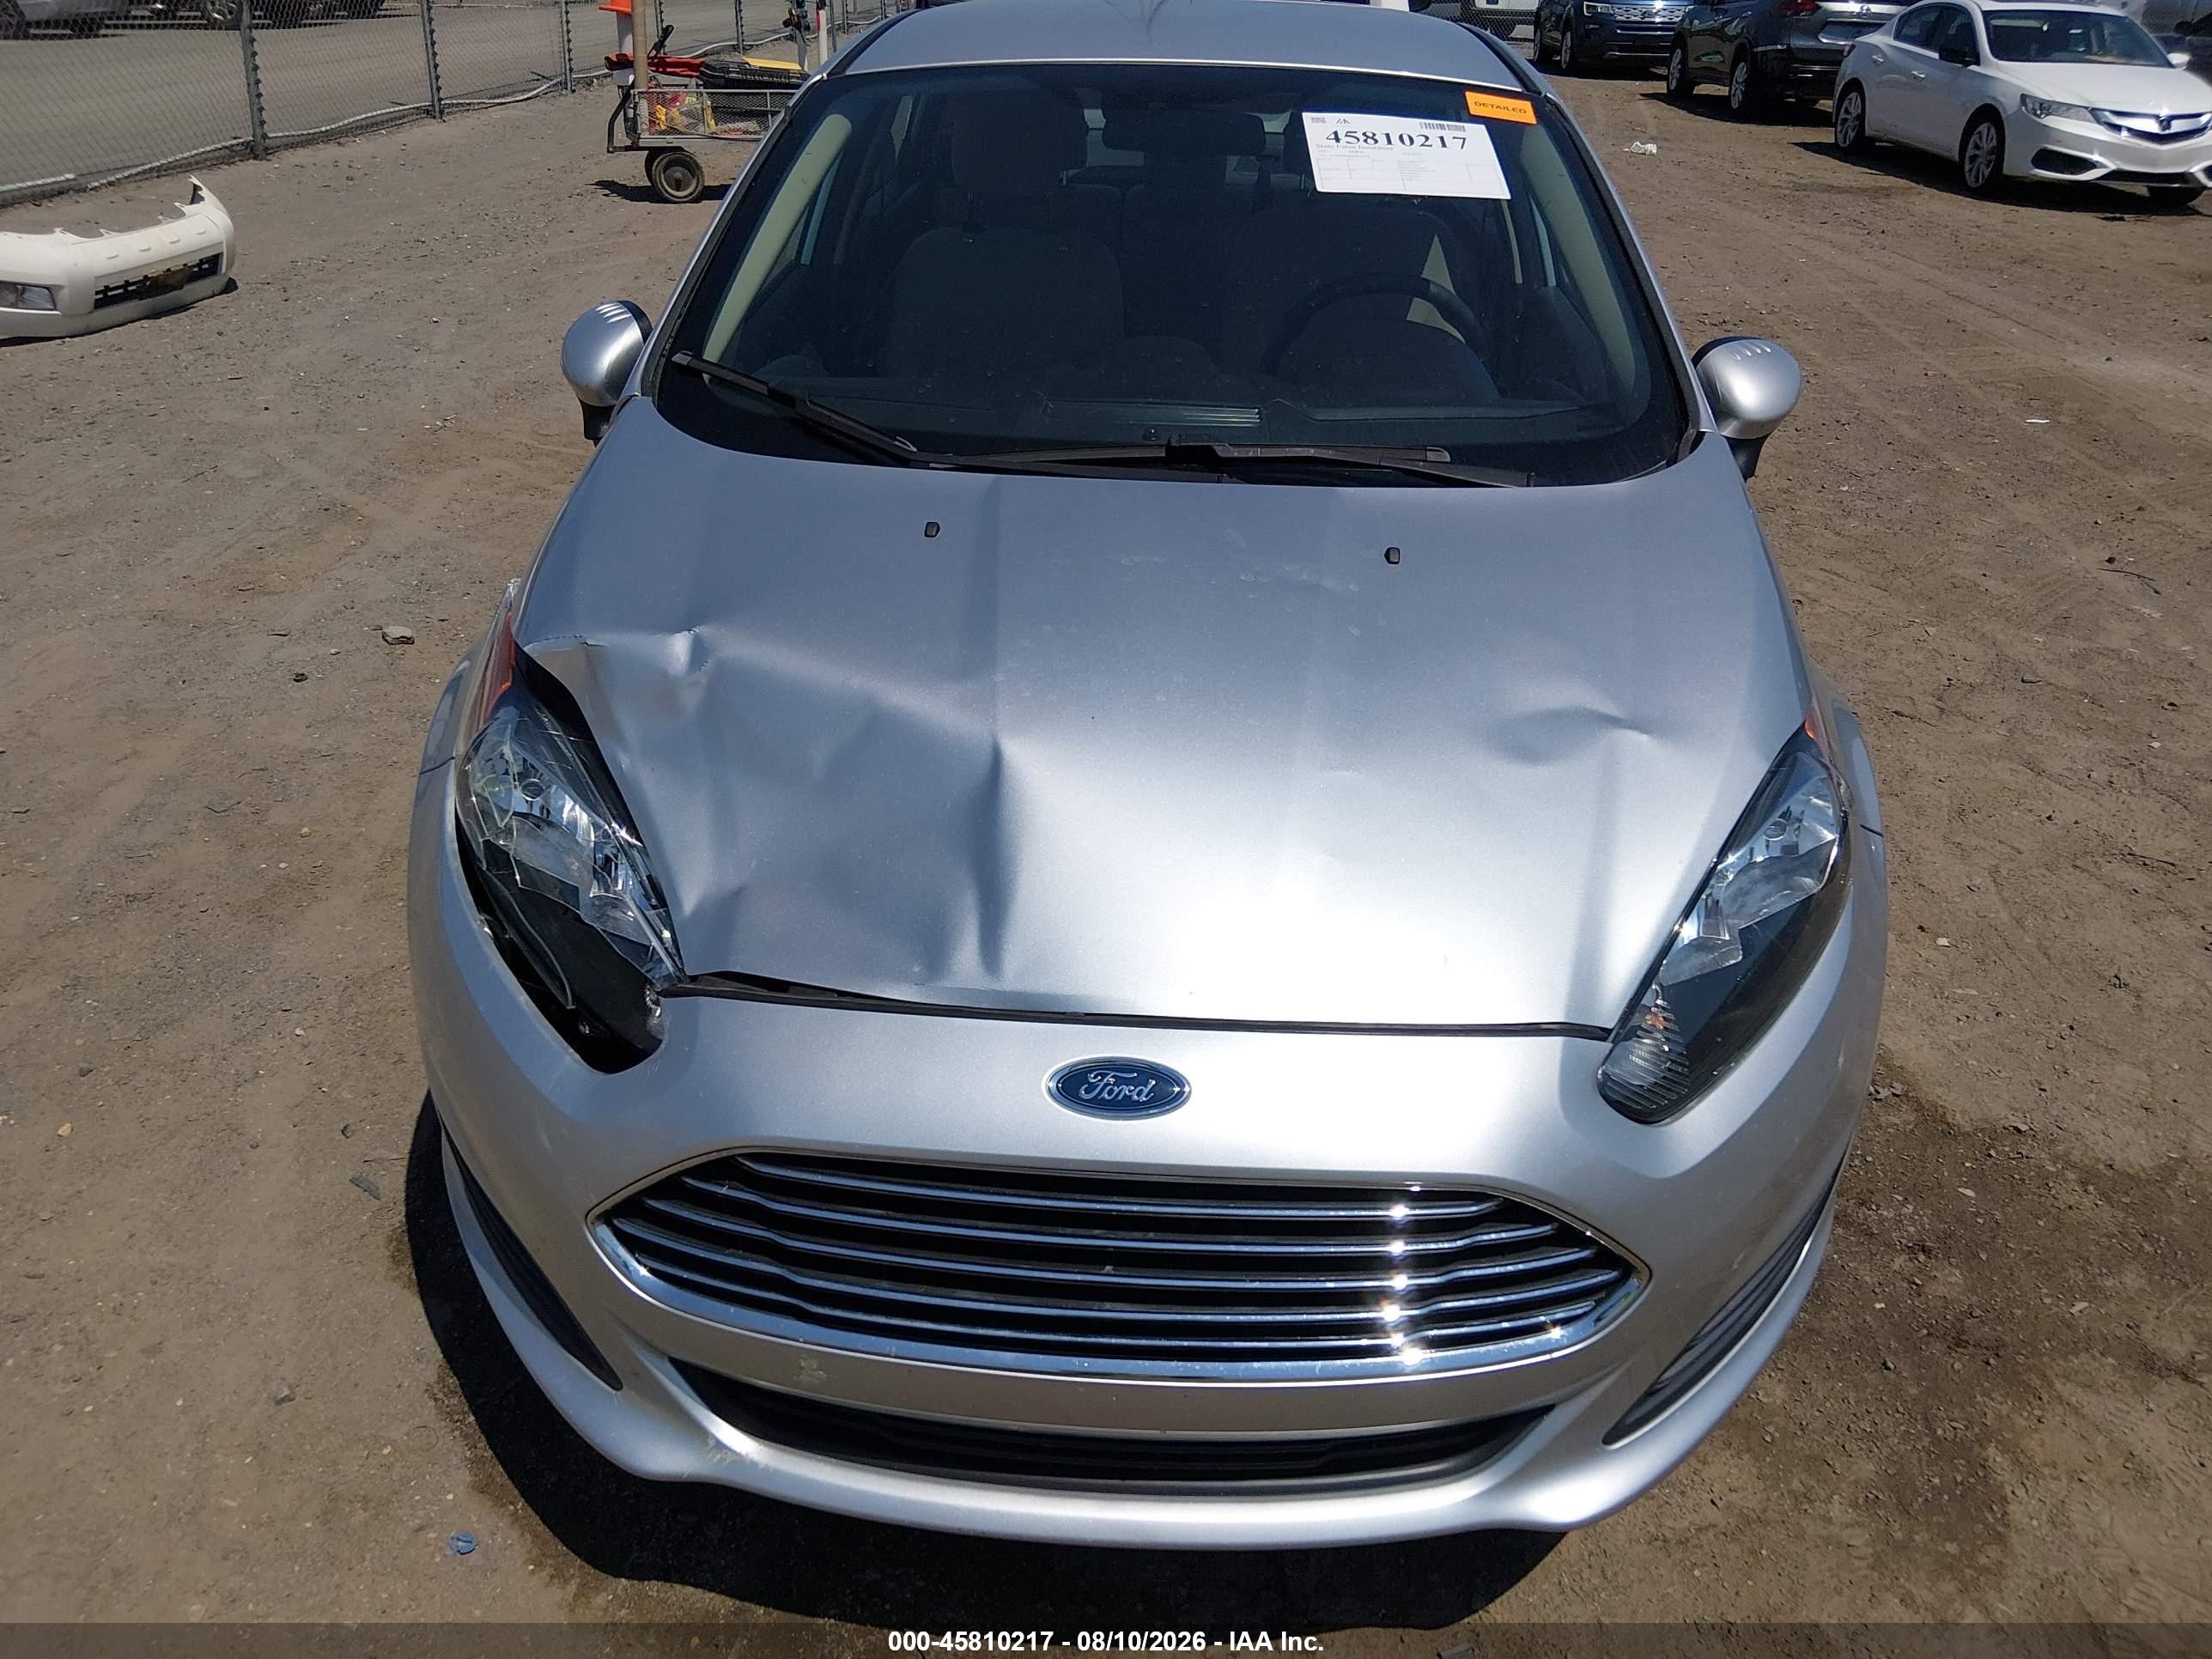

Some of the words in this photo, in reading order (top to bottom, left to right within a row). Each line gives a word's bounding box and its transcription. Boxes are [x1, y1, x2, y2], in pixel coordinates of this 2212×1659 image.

[1474, 101, 1527, 114] DETAILED
[1325, 130, 1467, 150] 45810217
[1079, 1070, 1157, 1103] Ford
